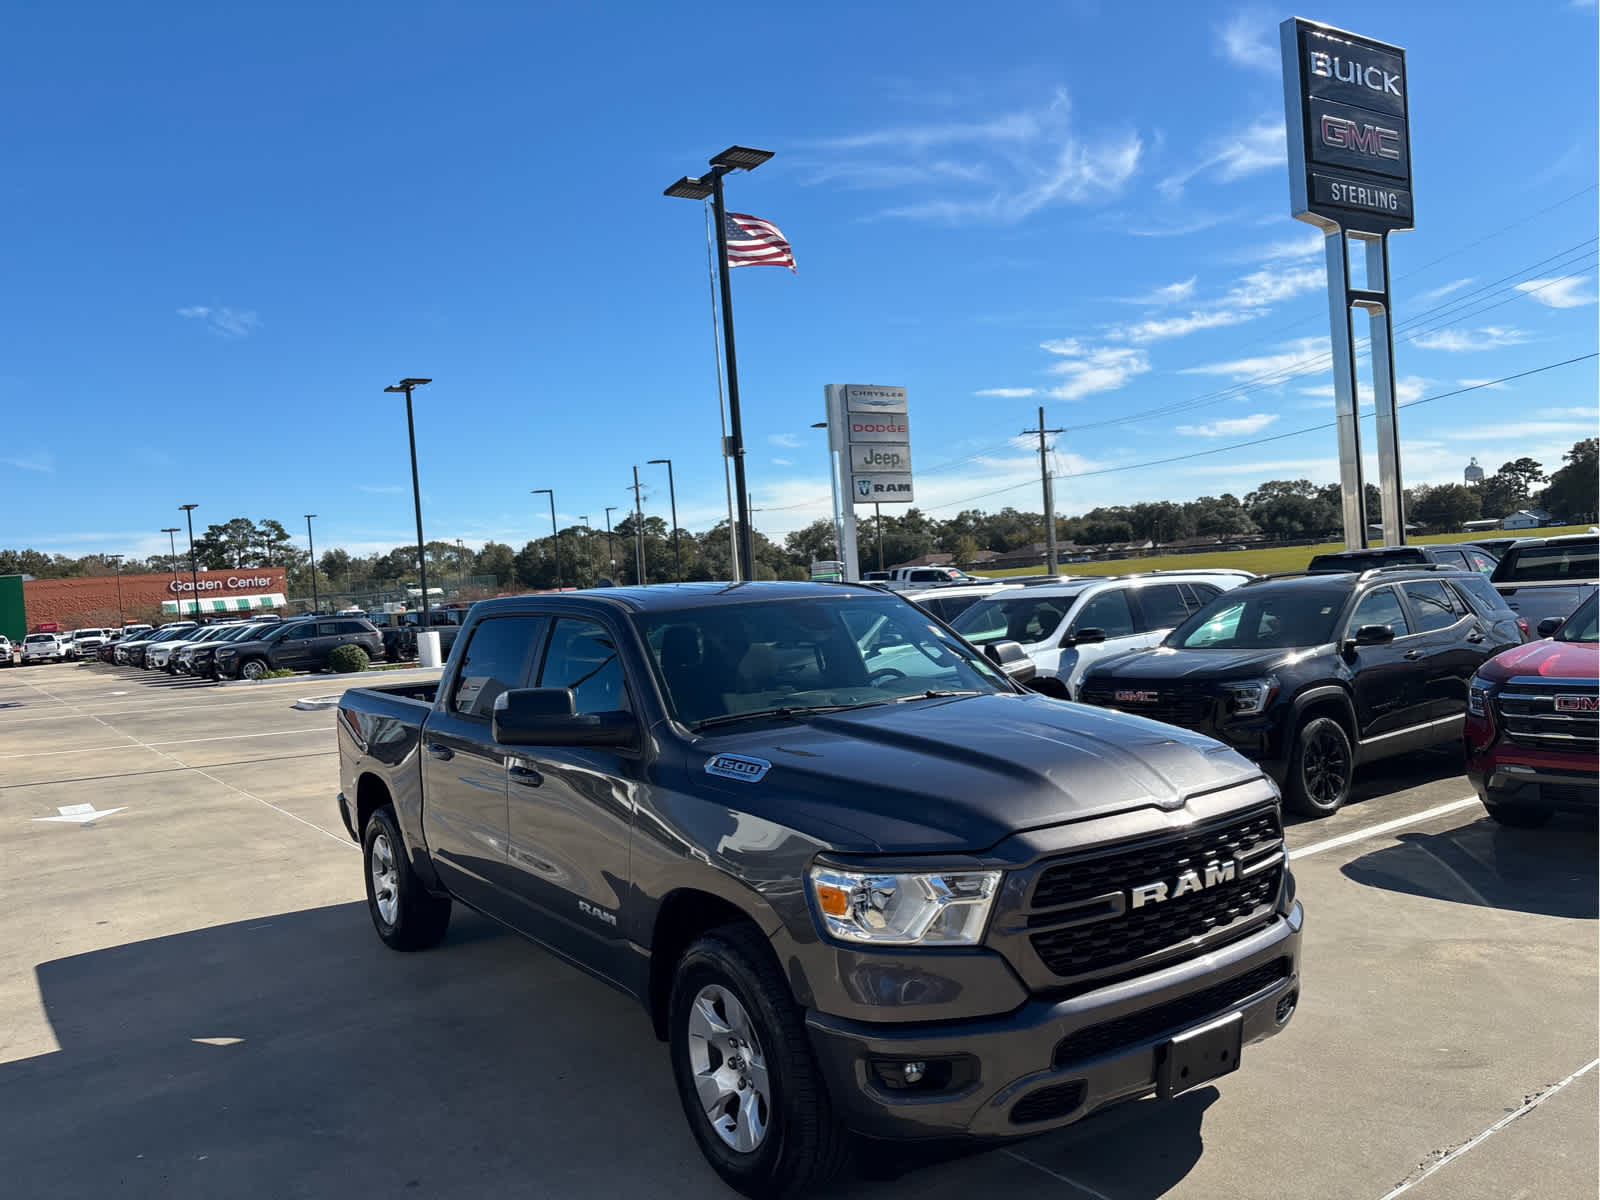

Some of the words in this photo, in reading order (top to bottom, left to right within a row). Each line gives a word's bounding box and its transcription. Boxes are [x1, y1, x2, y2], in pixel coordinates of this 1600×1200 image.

[1310, 51, 1401, 96] BUICK
[1321, 114, 1400, 161] GMC
[1331, 182, 1398, 210] STERLING
[851, 390, 904, 398] CHRYSLER
[852, 424, 906, 433] DODGE
[864, 448, 900, 468] Jeep
[873, 483, 911, 493] RAM
[169, 580, 223, 593] Garden
[227, 576, 271, 589] Center
[1115, 690, 1159, 702] GMC
[718, 758, 759, 773] 1500
[1131, 860, 1235, 909] RAM
[578, 900, 617, 926] RAM
